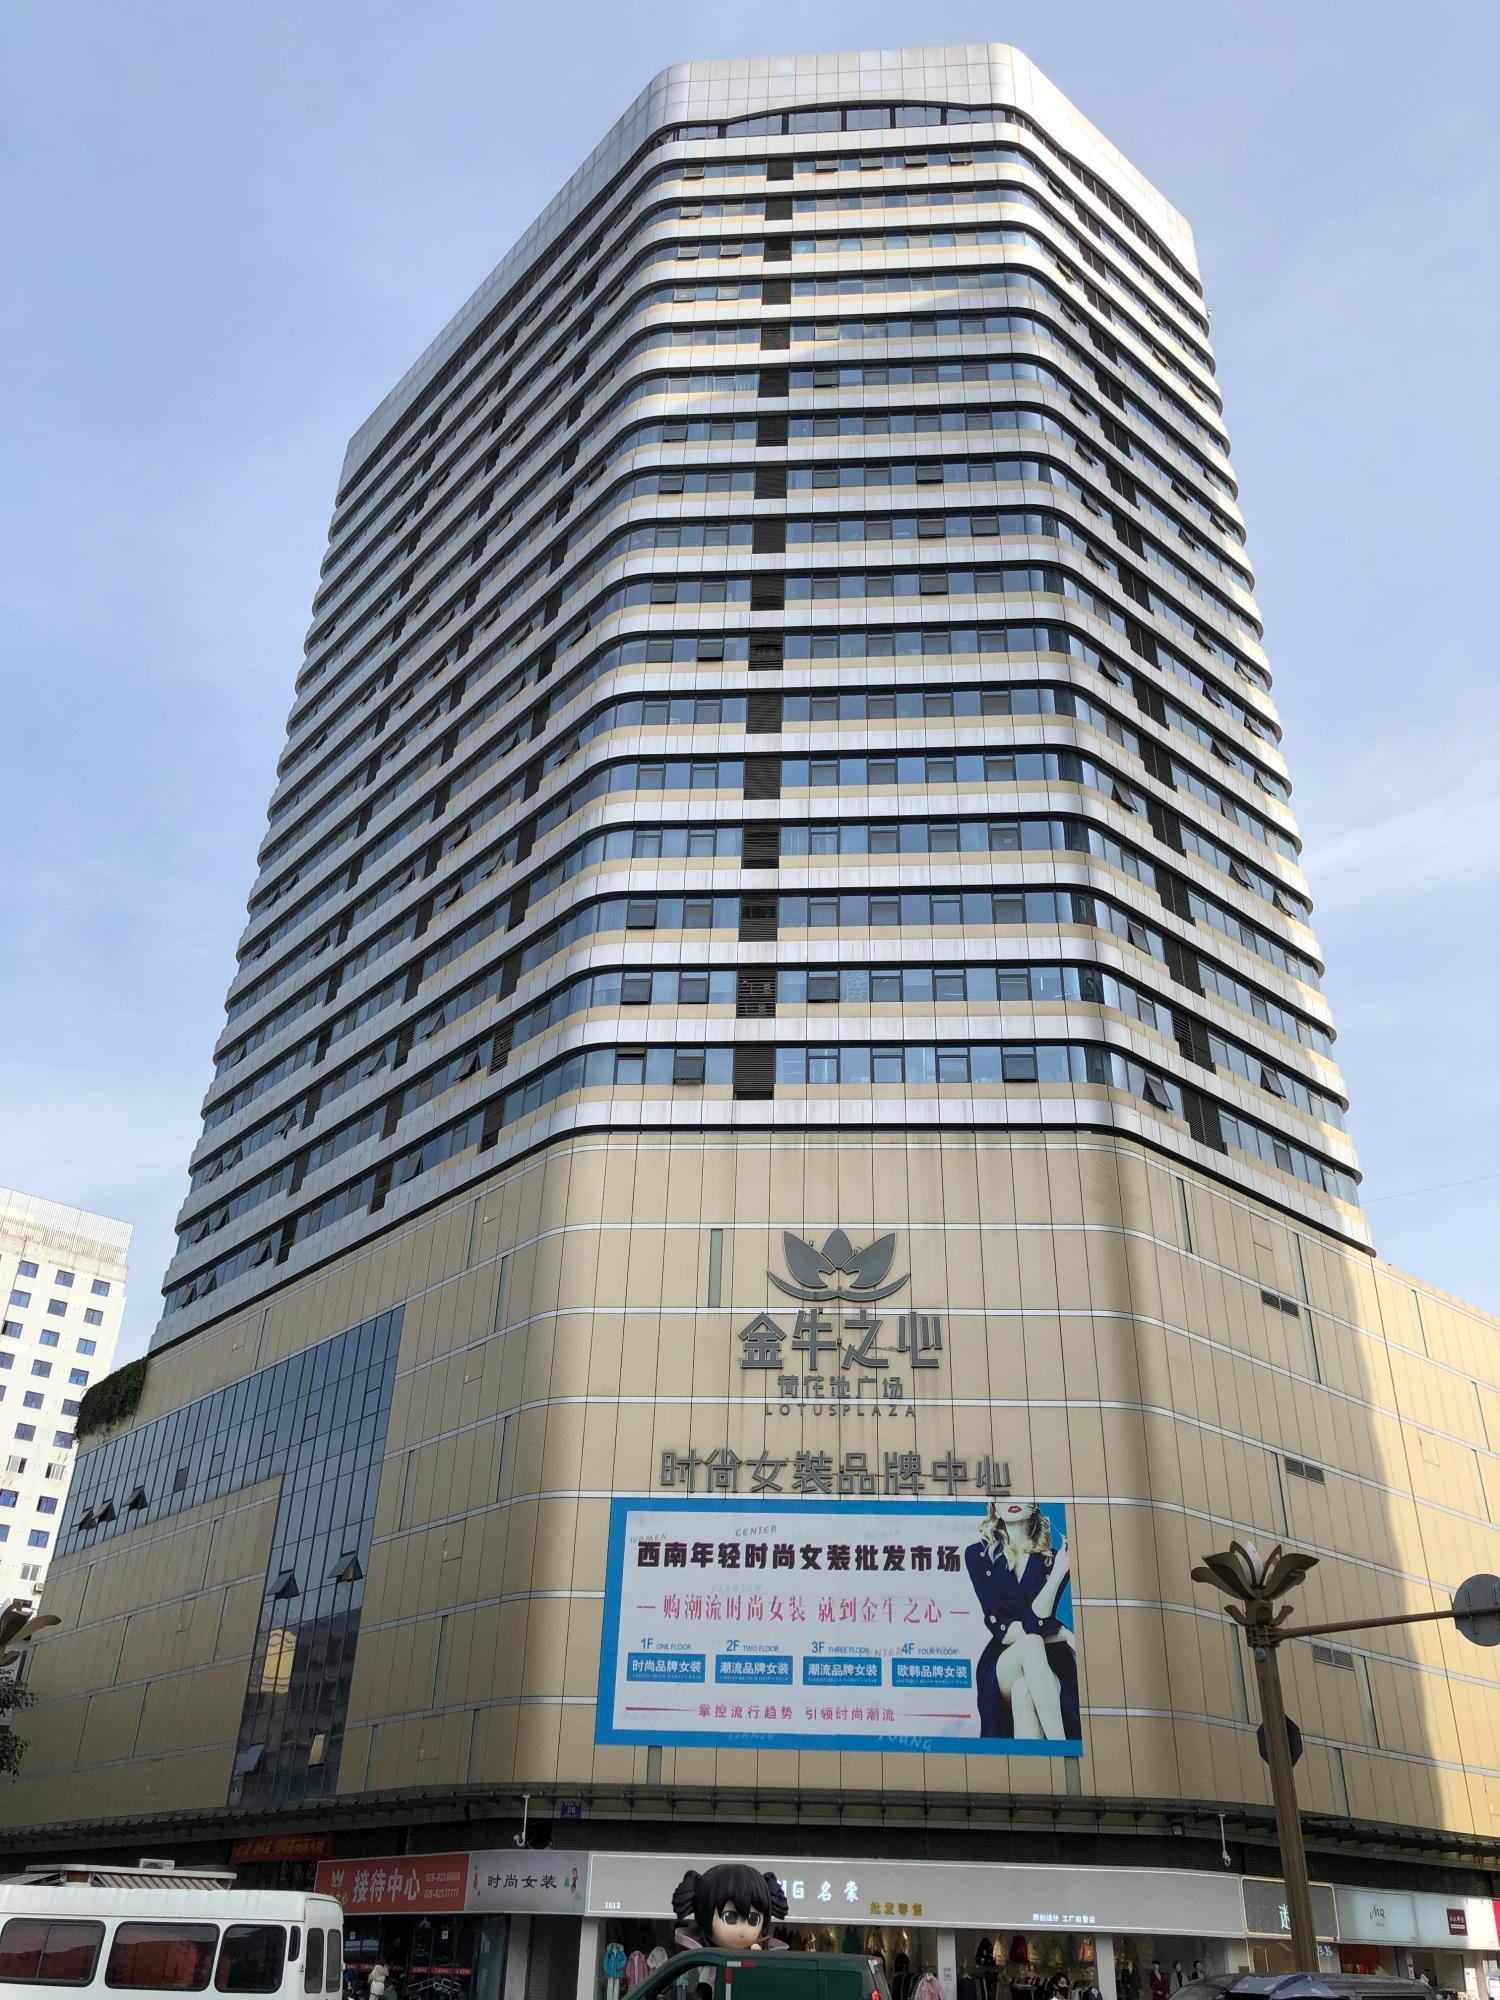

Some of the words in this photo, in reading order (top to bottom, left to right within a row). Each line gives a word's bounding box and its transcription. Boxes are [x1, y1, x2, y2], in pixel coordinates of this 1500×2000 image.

[738, 1308, 943, 1370] 金牛之心
[777, 1374, 904, 1399] 荷花池广场
[765, 1403, 916, 1417] LOTUSPLAZA
[735, 1525, 778, 1537] CENTER
[630, 1533, 668, 1544] WOMEN
[637, 1541, 961, 1572] 西南年轻时尚女装批发市场
[818, 1597, 943, 1624] 就到金牛之心
[640, 1638, 654, 1650] 1F
[670, 1643, 692, 1651] FLOOR
[726, 1640, 740, 1652] 2F
[811, 1641, 825, 1653] 3F
[901, 1643, 915, 1655] 4F
[632, 1659, 702, 1673] 时尚品牌女装
[720, 1661, 789, 1675] 潮流品牌女装
[808, 1663, 878, 1677] 潮流品牌女装
[897, 1664, 968, 1679] 欧韩品牌女装
[698, 1704, 793, 1720] 掌控流行趋势
[805, 1706, 895, 1722] 引领时尚潮流
[352, 1867, 421, 1903] 接待中心
[487, 1873, 558, 1890] 时尚女装
[870, 1901, 923, 1916] 批发零售
